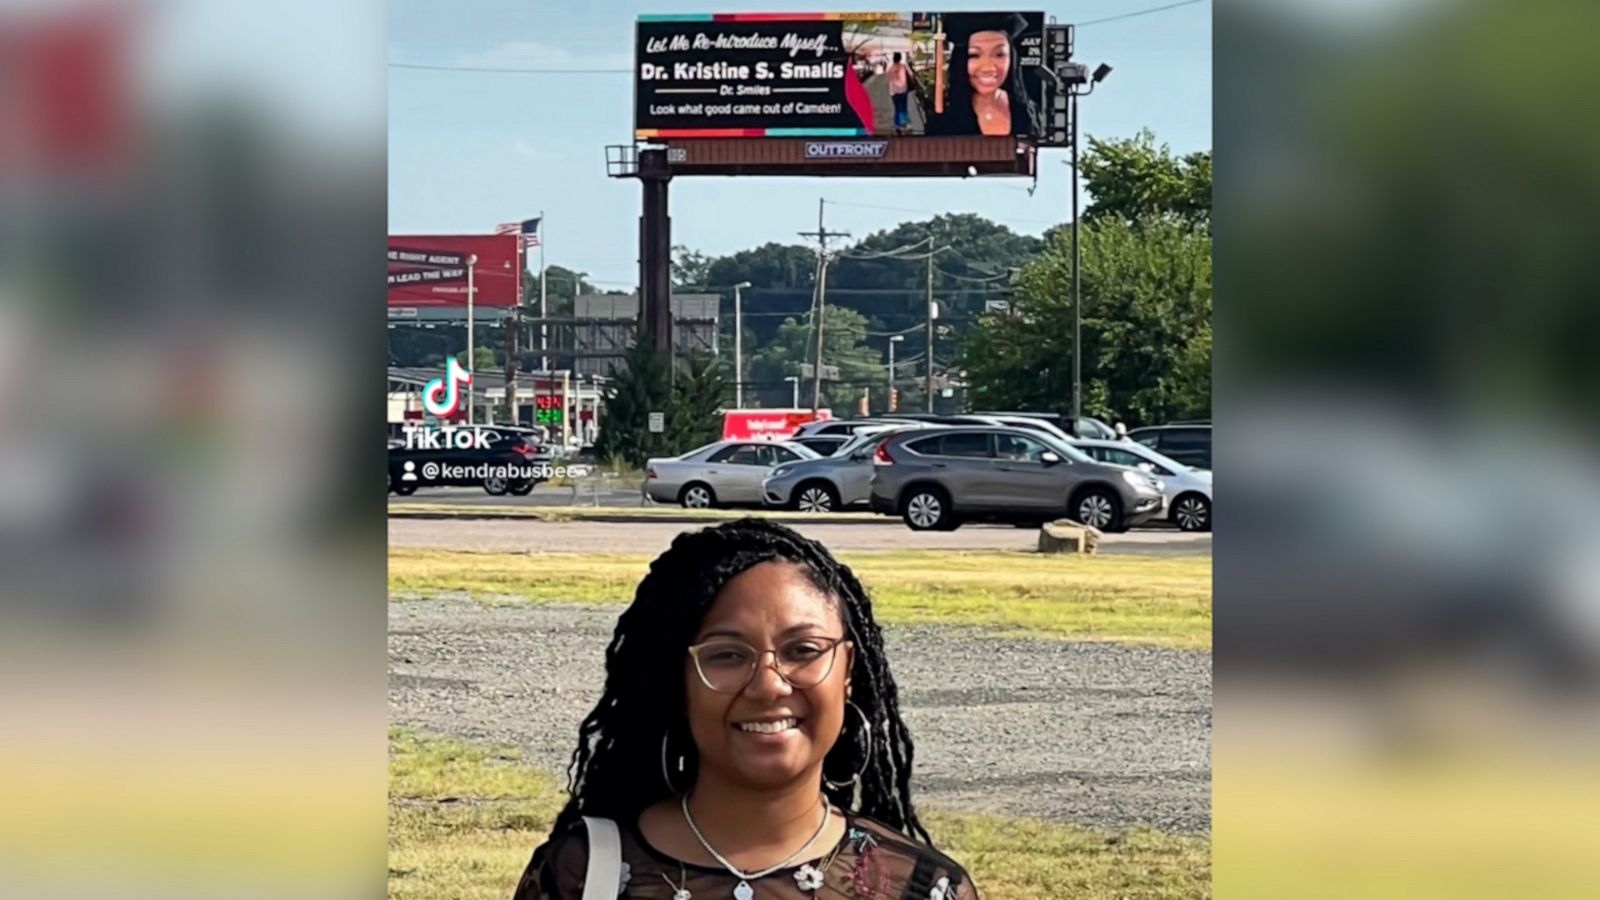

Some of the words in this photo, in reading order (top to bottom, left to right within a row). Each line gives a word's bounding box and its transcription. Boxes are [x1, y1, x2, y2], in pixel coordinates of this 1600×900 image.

[646, 36, 668, 53] Let
[669, 34, 690, 51] Me
[692, 32, 778, 50] Re-Introduce
[780, 33, 839, 57] Myself...
[641, 63, 669, 80] Dr.
[674, 61, 750, 80] Kristine
[755, 61, 775, 80] S.
[780, 61, 844, 80] Smalls
[719, 85, 735, 96] Dr.
[736, 84, 771, 96] Smiles
[650, 104, 675, 115] Look
[678, 104, 703, 115] what
[704, 103, 731, 117] good
[732, 105, 761, 115] came
[762, 104, 781, 115] out
[782, 102, 794, 114] of
[795, 102, 841, 114] Camden!
[807, 142, 883, 156] OUTFRONT
[399, 251, 427, 262] RIGHT
[428, 255, 459, 264] AGENT
[396, 272, 421, 283] LEAD
[422, 270, 441, 280] THE
[441, 269, 464, 278] WAY
